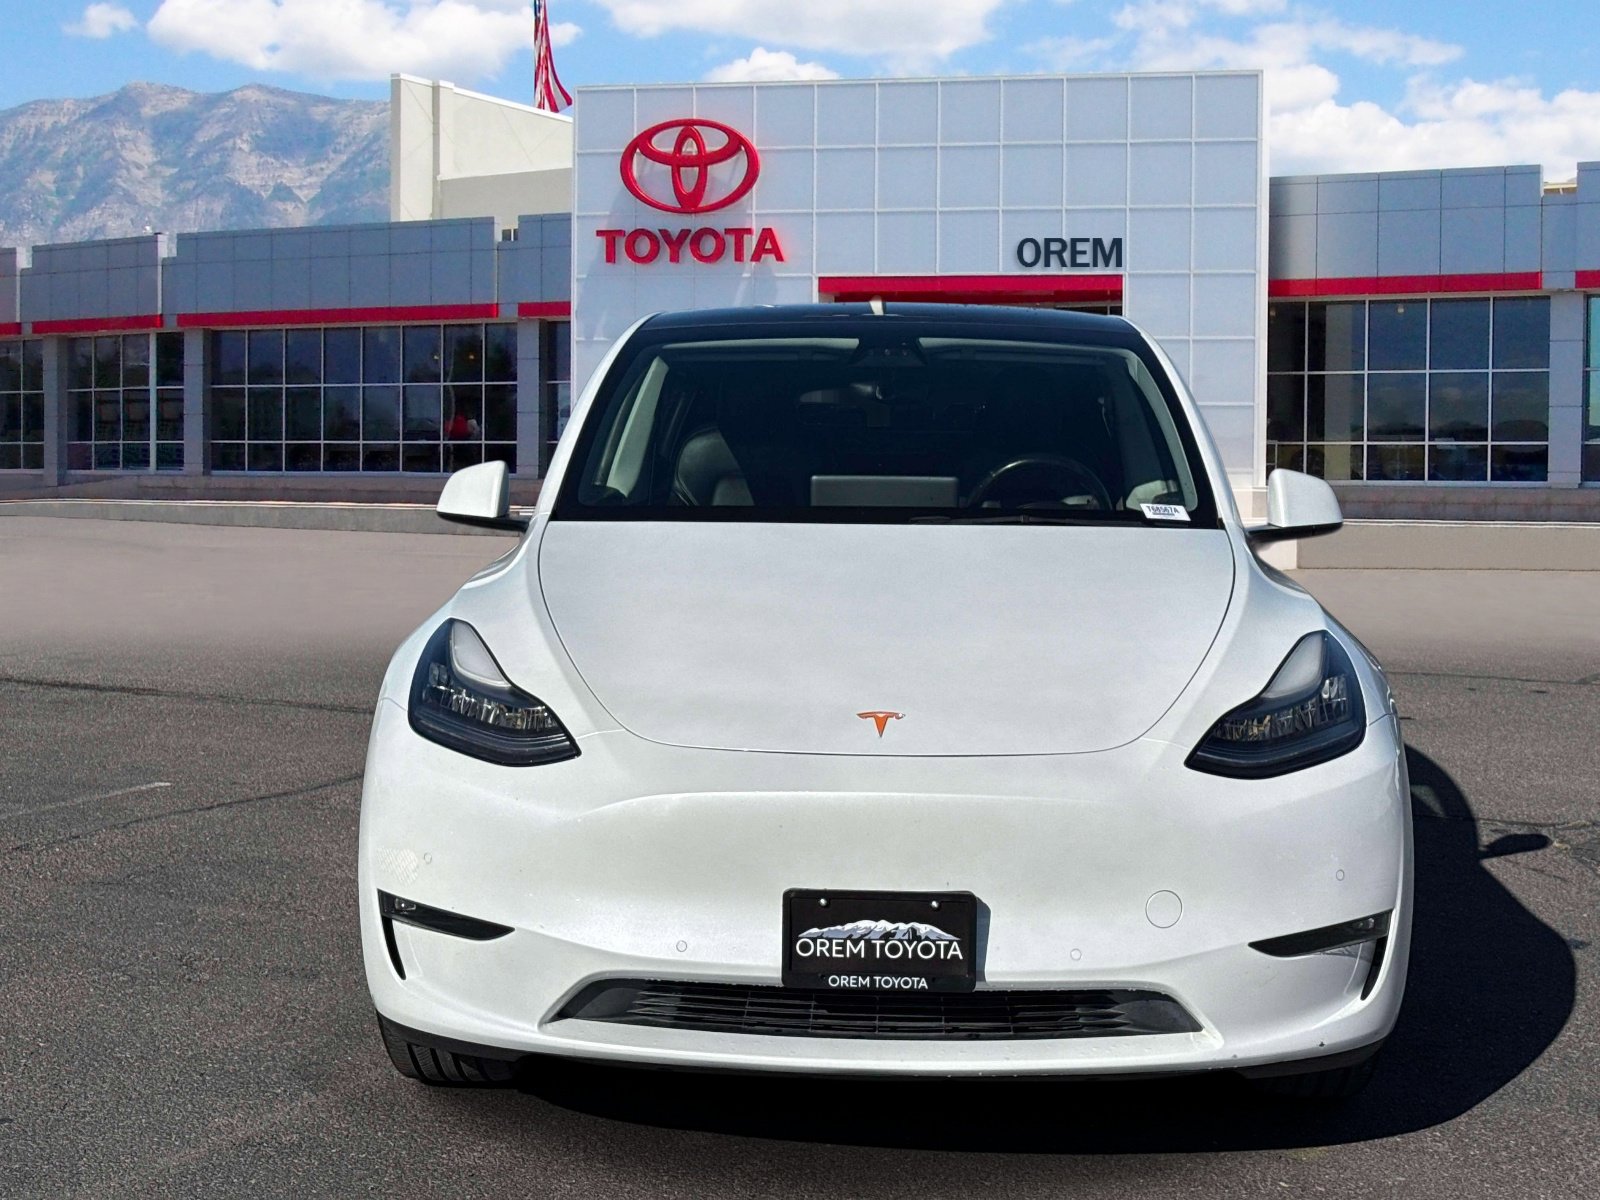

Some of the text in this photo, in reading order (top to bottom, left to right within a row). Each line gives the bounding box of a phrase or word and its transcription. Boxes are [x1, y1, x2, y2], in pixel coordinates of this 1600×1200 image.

[596, 227, 785, 264] TOYOTA
[1016, 237, 1123, 268] OREM
[796, 938, 963, 960] OREM TOYOTA
[828, 975, 928, 989] OREM TOYOTA
